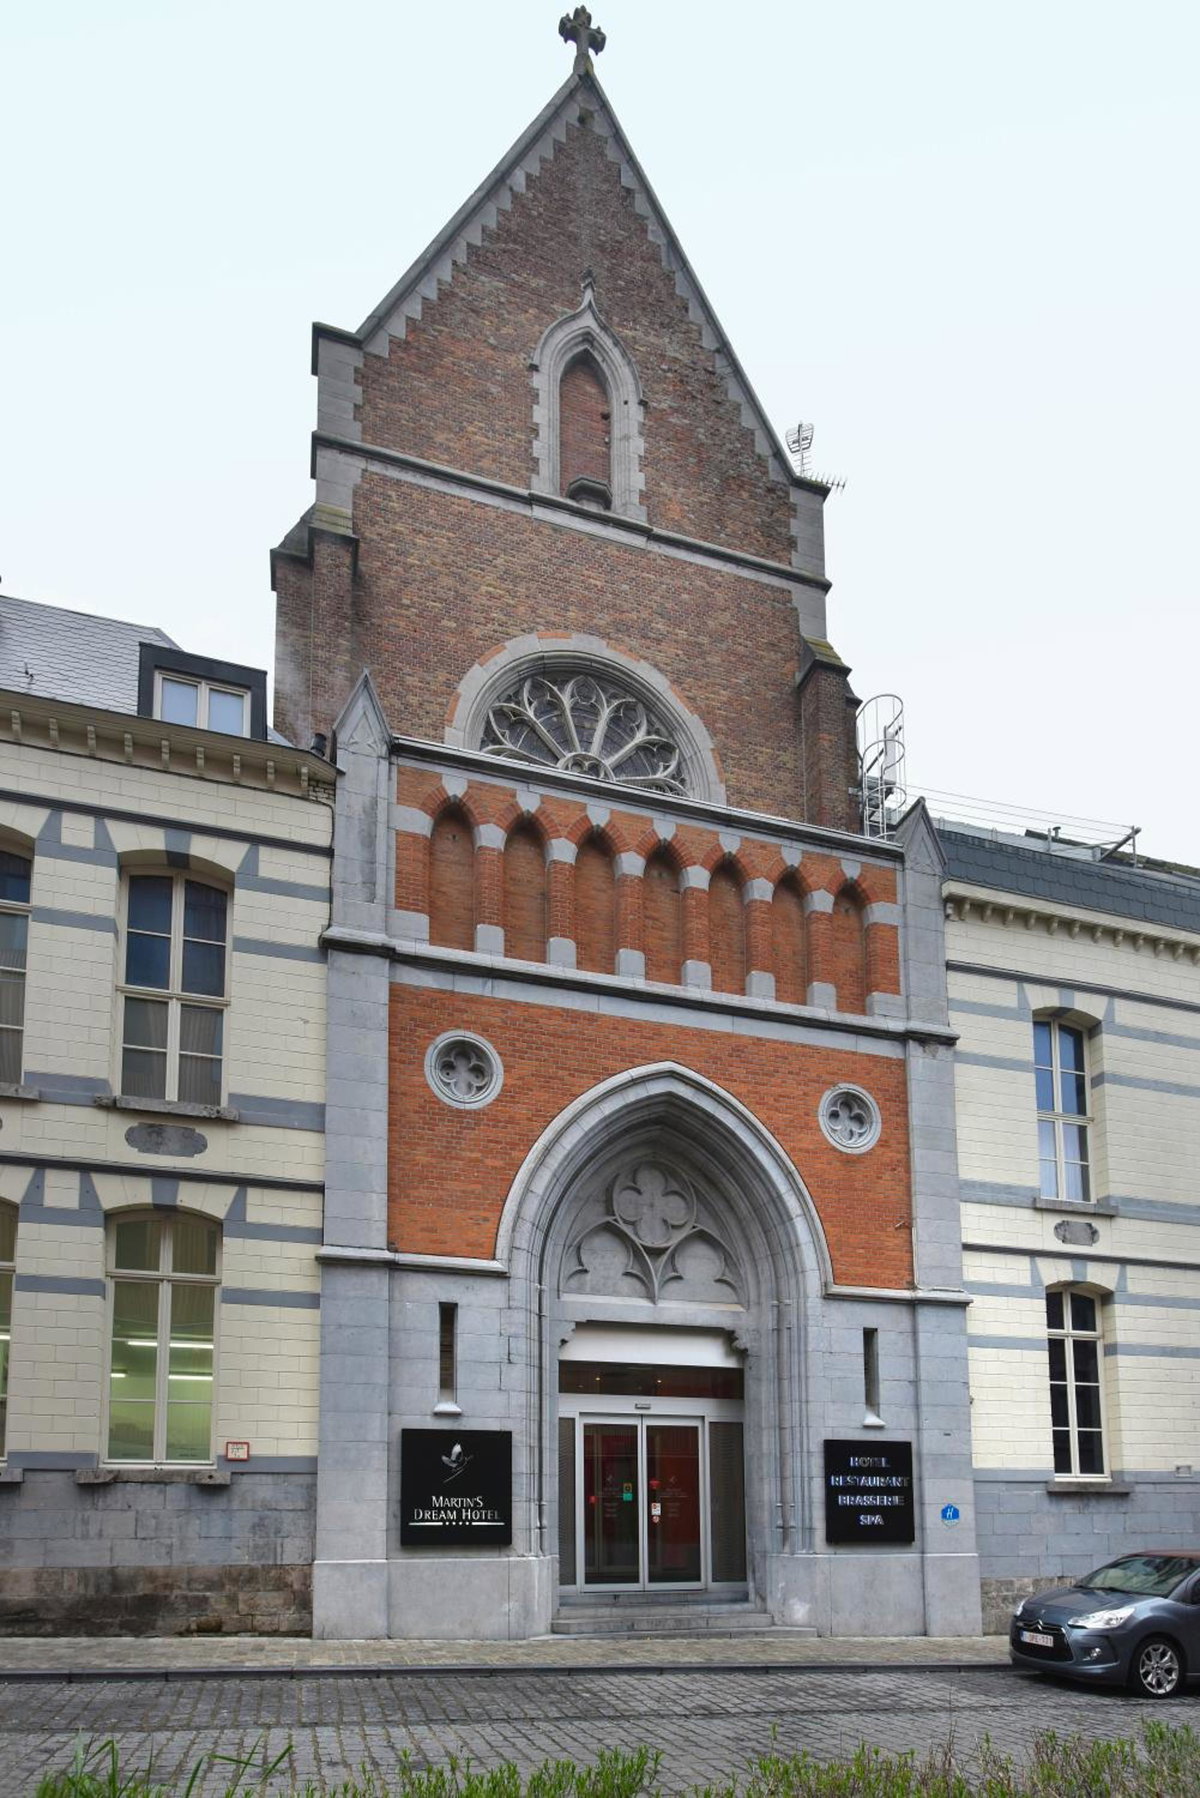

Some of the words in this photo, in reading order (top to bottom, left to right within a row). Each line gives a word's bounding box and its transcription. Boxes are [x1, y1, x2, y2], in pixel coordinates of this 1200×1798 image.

[850, 1457, 890, 1467] HOTEL
[831, 1475, 910, 1487] RESTAURANT
[432, 1495, 484, 1508] MARTIN'S
[839, 1495, 905, 1506] BRASSERIE
[414, 1508, 457, 1520] DREAM
[462, 1508, 500, 1520] HOTEL
[860, 1514, 885, 1526] SPA
